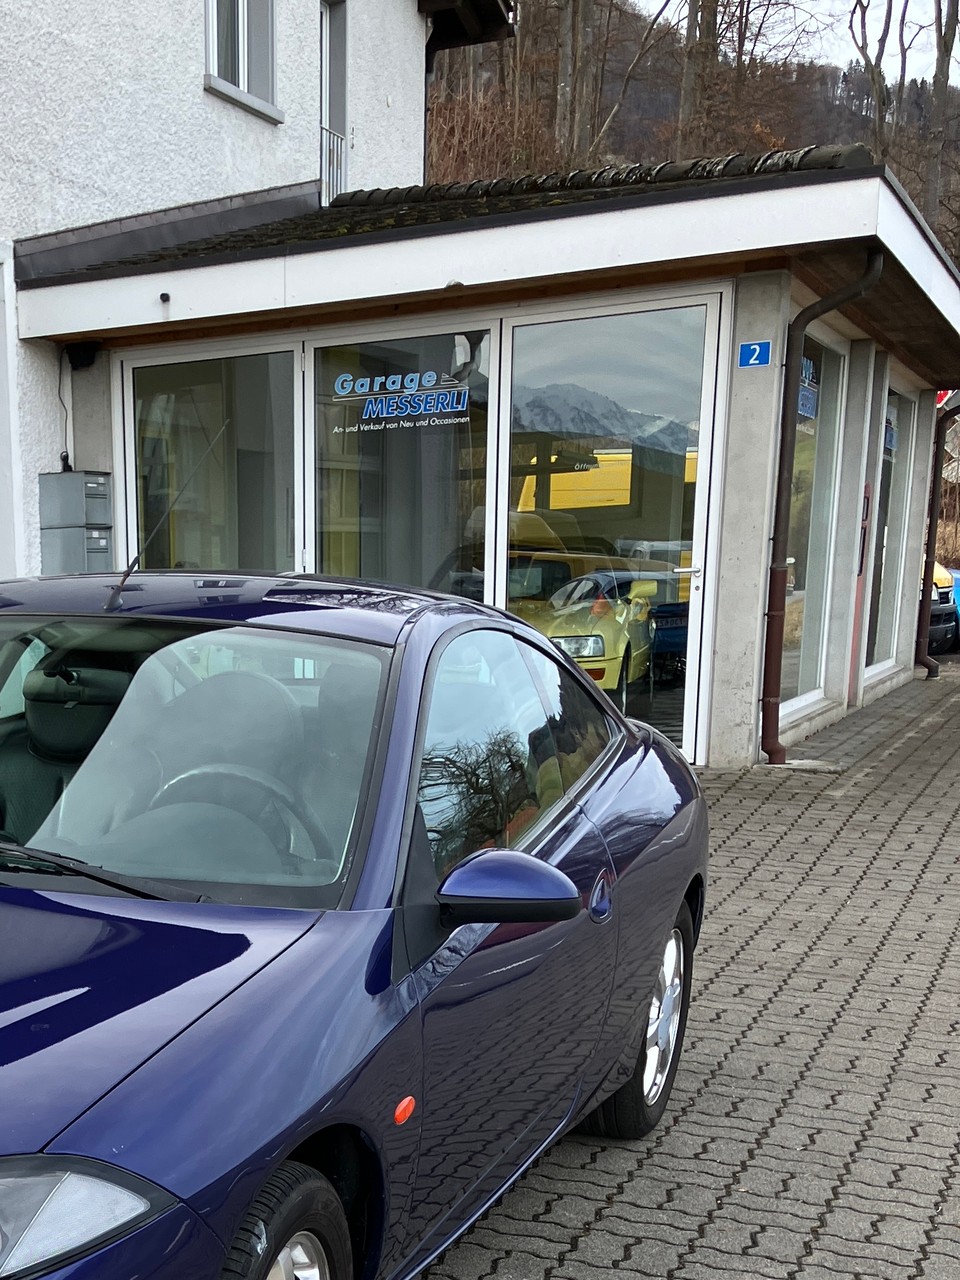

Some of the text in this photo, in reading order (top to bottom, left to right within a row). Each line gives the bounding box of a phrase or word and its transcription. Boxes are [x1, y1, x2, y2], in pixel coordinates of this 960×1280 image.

[749, 344, 760, 364] 2
[334, 370, 438, 395] Garage
[362, 388, 469, 419] MESSERLI
[345, 423, 358, 432] und
[359, 421, 385, 431] Verkauf
[399, 420, 414, 428] Neu
[415, 417, 429, 426] und
[430, 416, 470, 426] Occasionen
